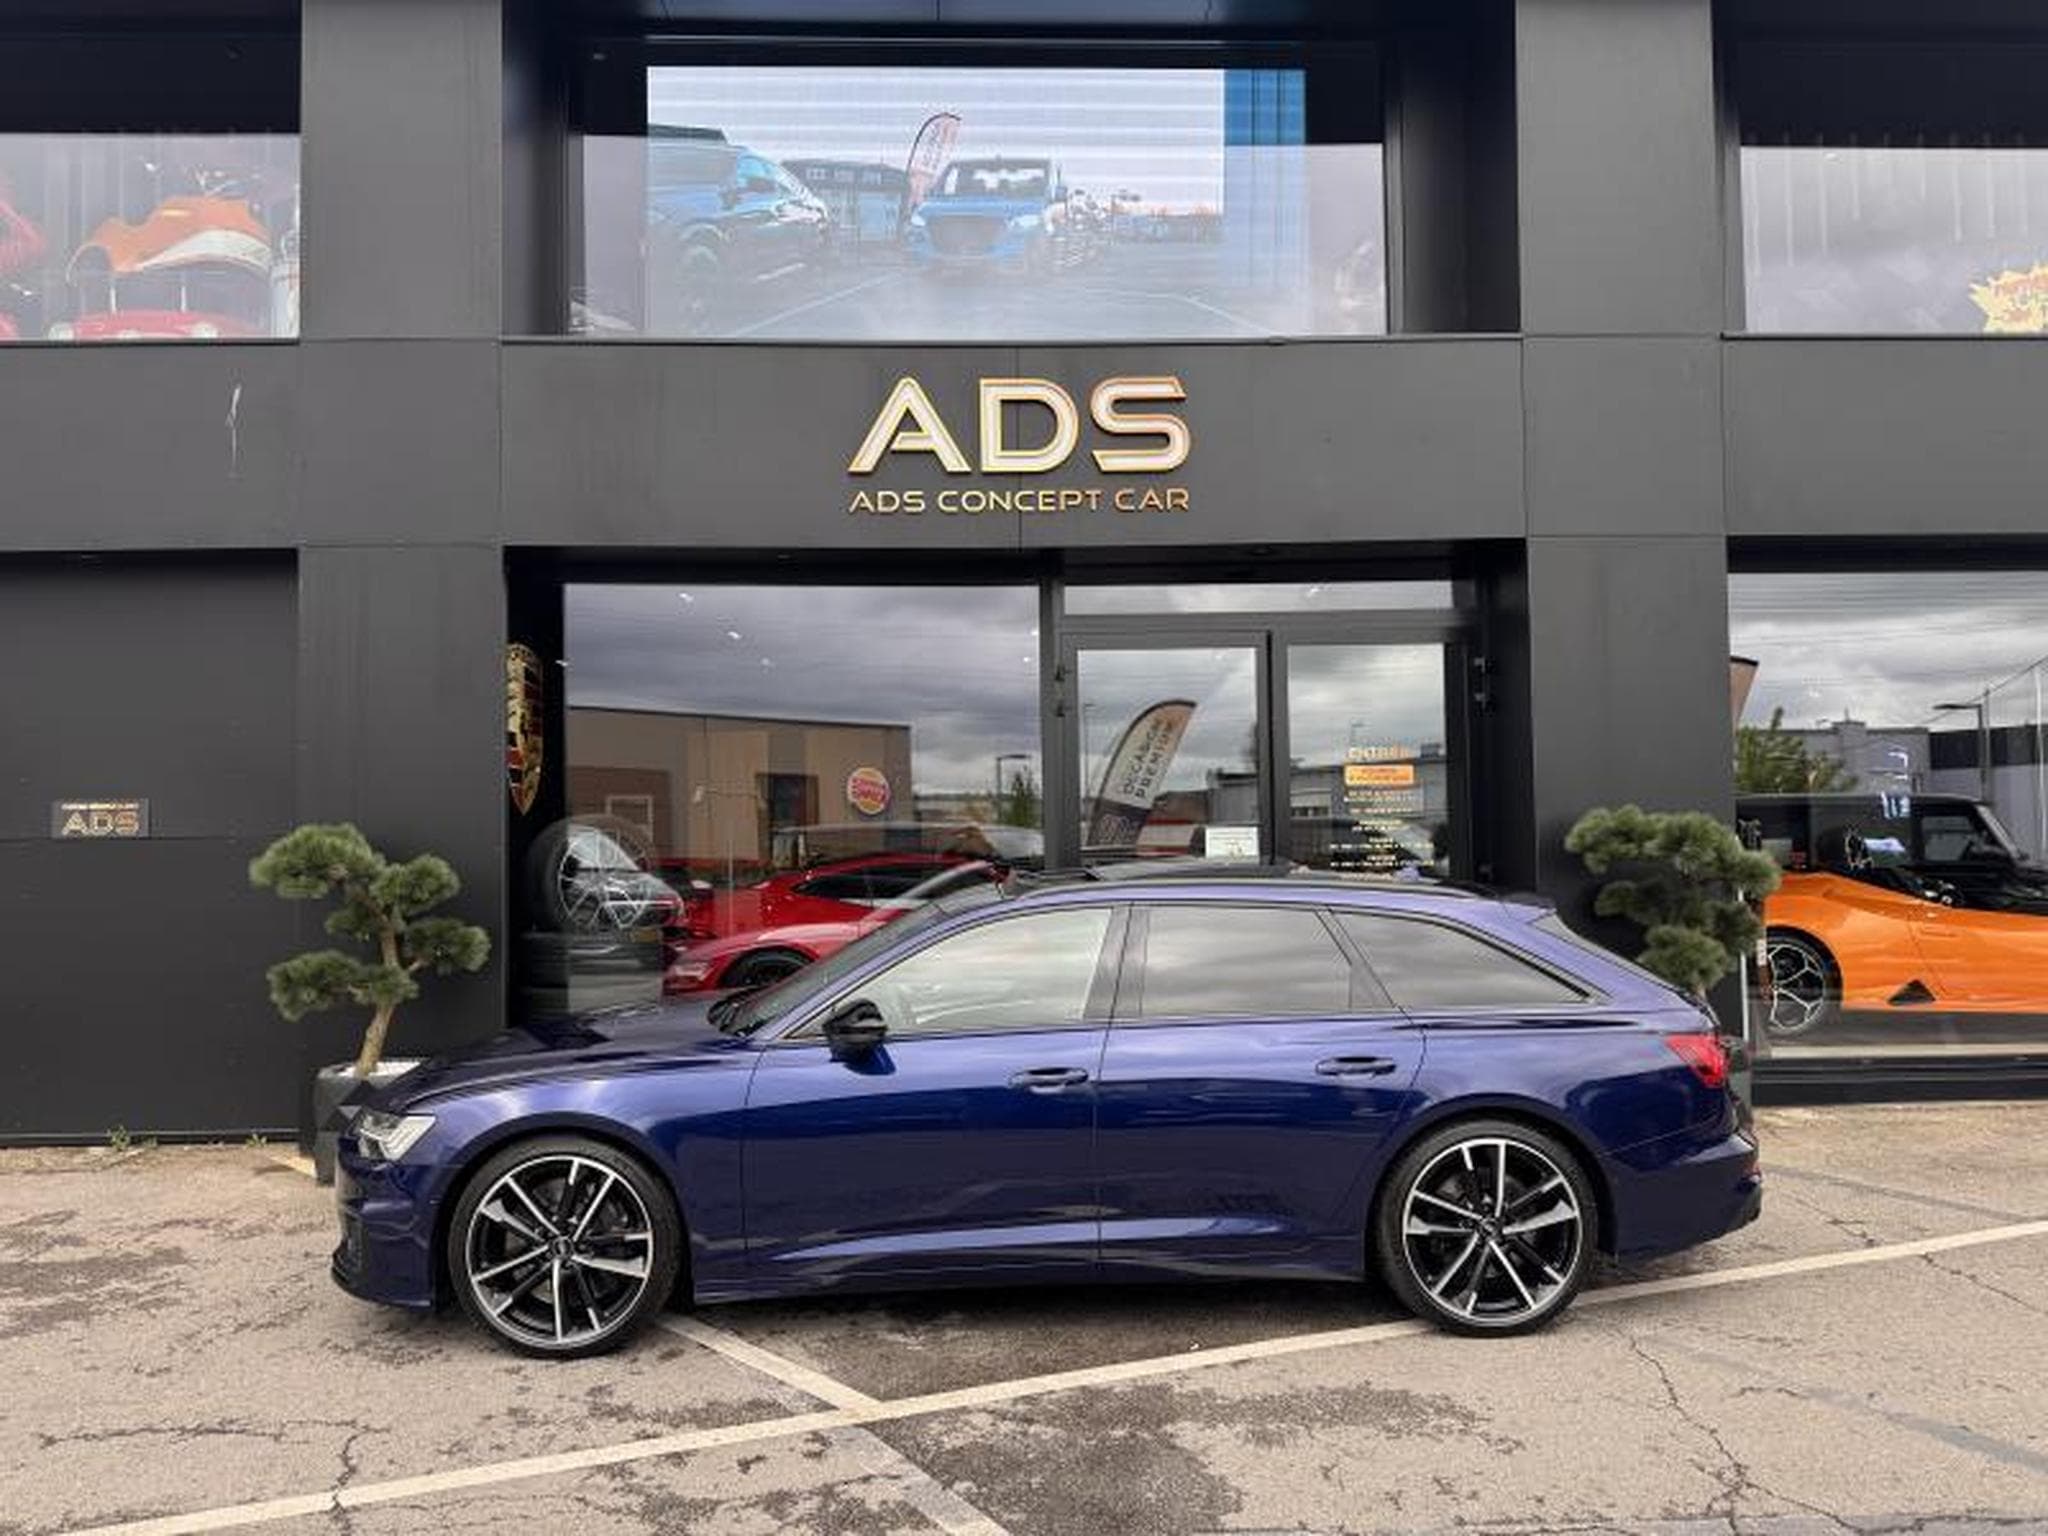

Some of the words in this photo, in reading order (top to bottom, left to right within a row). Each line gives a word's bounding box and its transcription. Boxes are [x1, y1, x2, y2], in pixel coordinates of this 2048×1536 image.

[848, 376, 1191, 473] ADS
[849, 490, 925, 513] ADS
[938, 489, 1101, 513] CONCEPT
[1115, 488, 1189, 511] CAR
[61, 811, 139, 836] ADS
